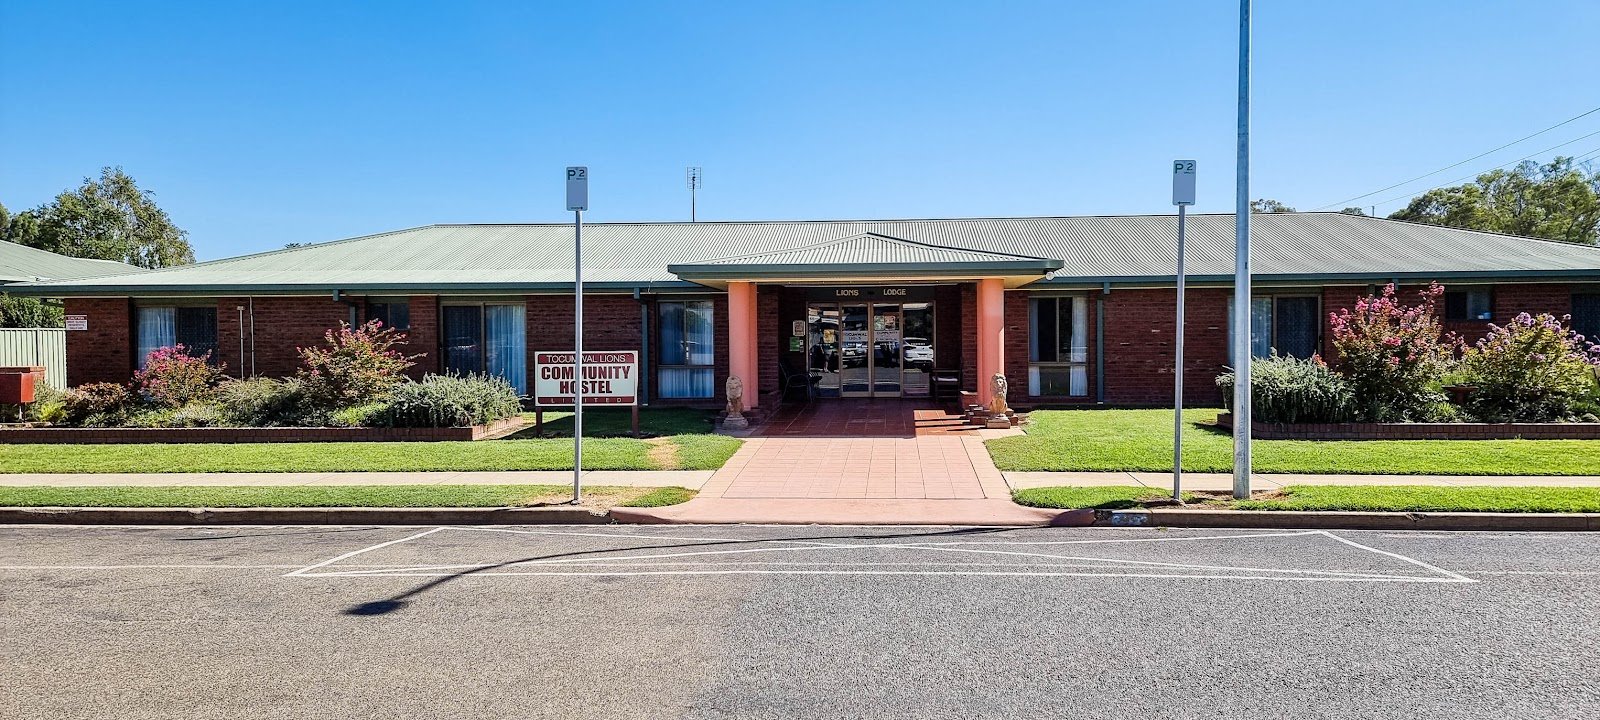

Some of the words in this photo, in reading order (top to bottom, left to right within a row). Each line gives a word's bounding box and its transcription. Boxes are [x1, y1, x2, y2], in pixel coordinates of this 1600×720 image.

[883, 288, 907, 296] LODGE
[600, 354, 626, 363] LIONS
[560, 381, 613, 394] HOSTEL
